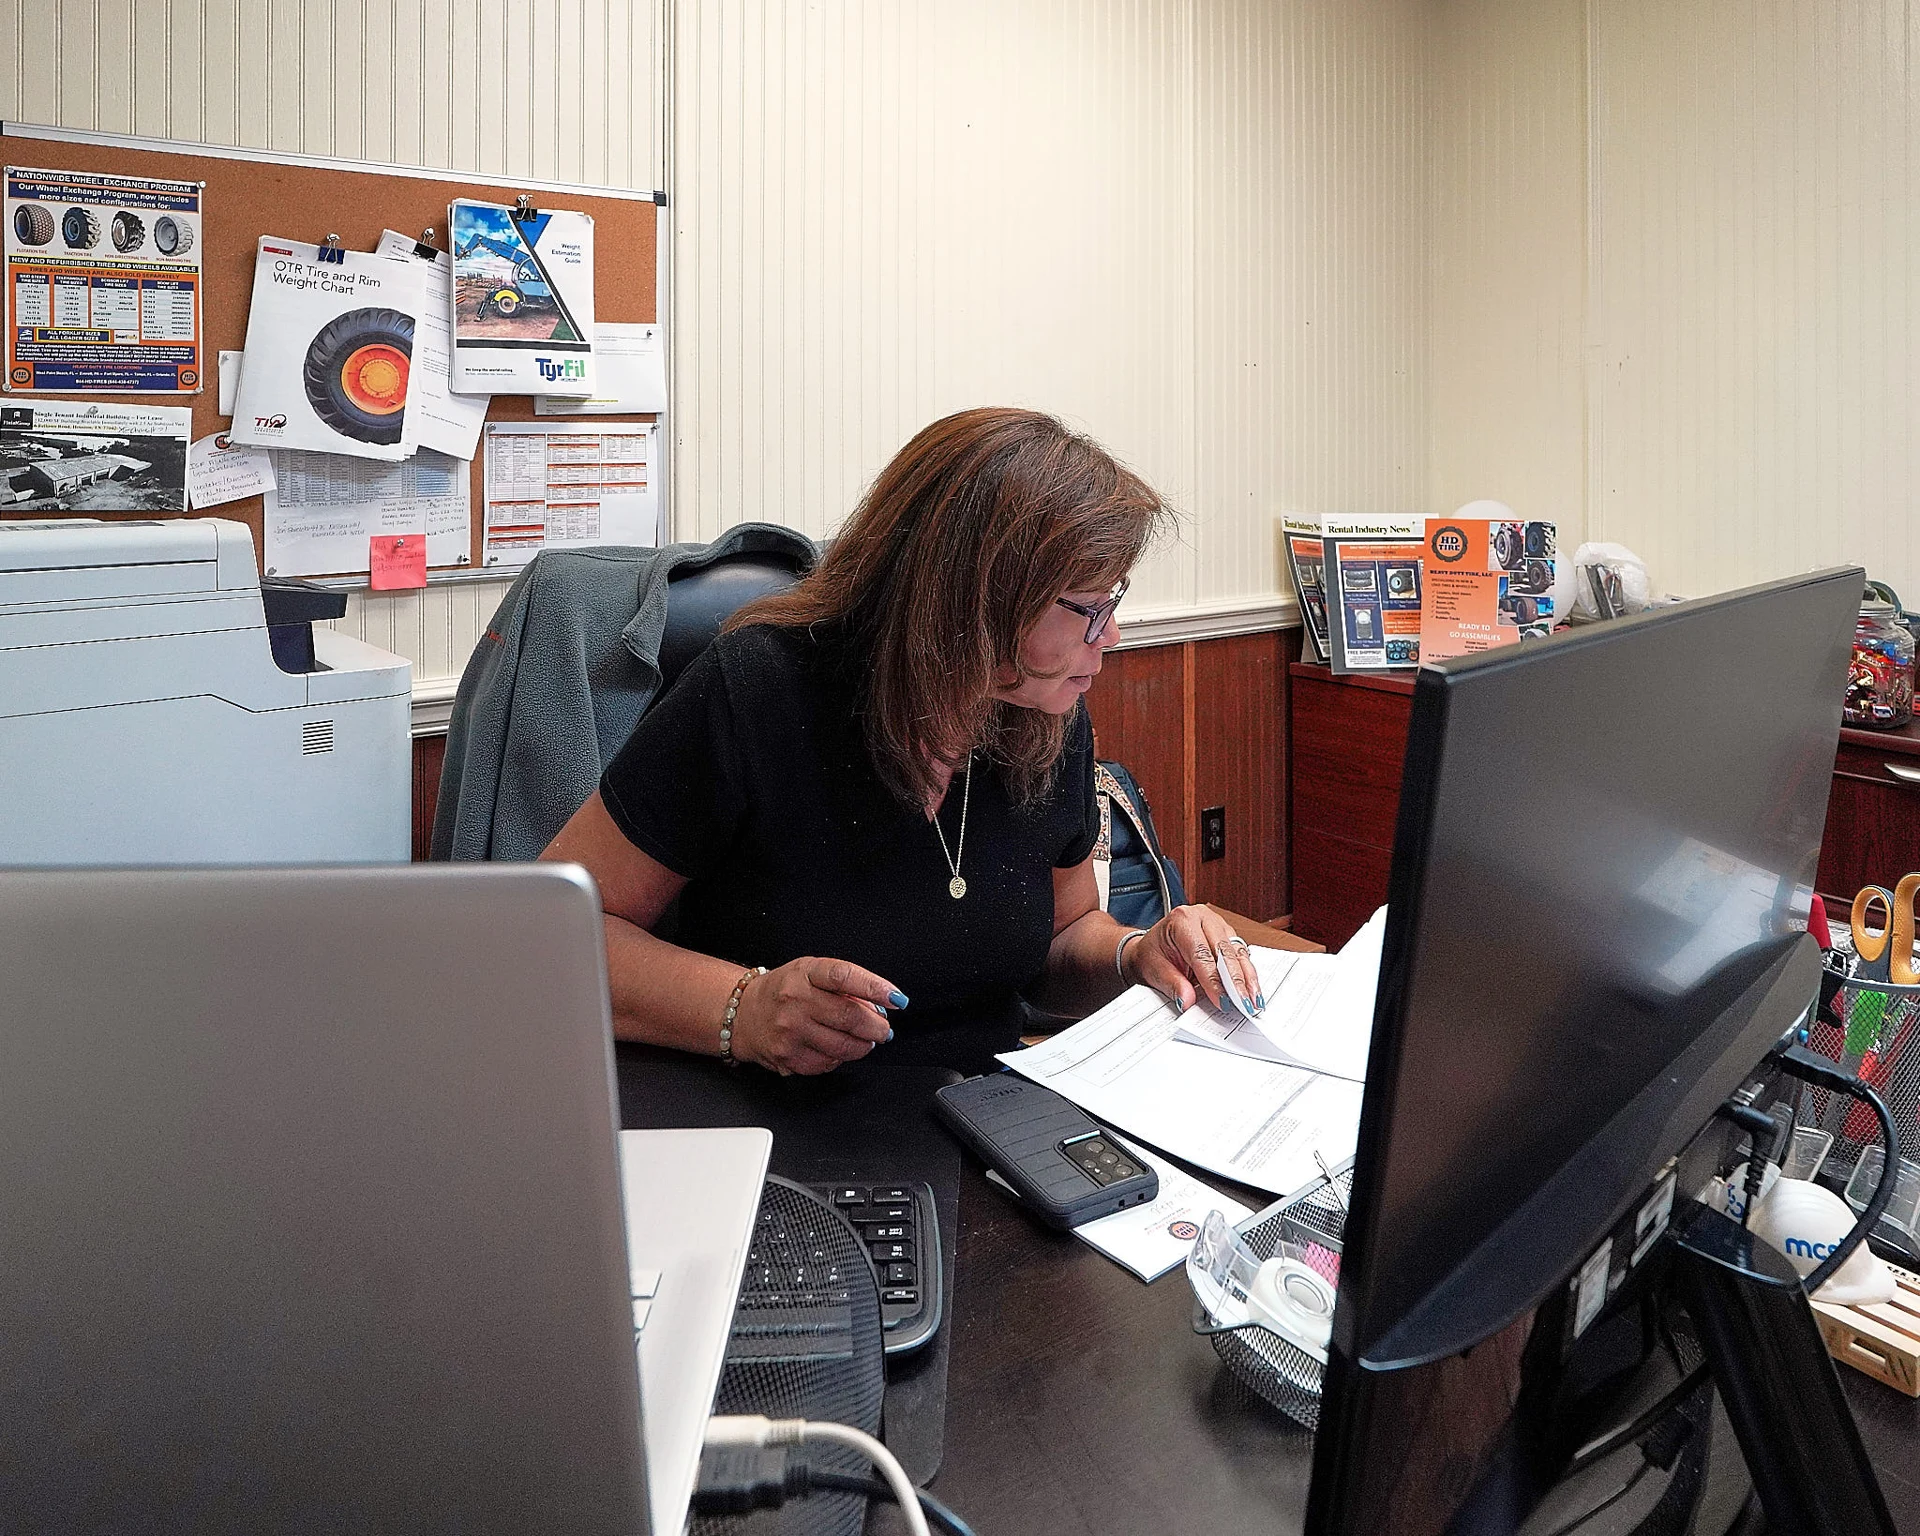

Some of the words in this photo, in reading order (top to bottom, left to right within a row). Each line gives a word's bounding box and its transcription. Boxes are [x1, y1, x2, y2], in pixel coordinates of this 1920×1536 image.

[16, 172, 71, 183] NATIONWIDE
[72, 176, 103, 185] WHEEL
[104, 178, 149, 189] EXCHANGE
[150, 183, 191, 193] PROGRAM
[35, 184, 61, 192] Wheel
[62, 186, 102, 197] Exchange
[103, 190, 139, 200] Program,
[158, 195, 189, 204] includes
[62, 194, 82, 202] sizes
[84, 196, 99, 204] and
[100, 198, 156, 209] configurations
[551, 249, 582, 257] Estimation
[46, 258, 95, 267] REFURBISHED
[274, 260, 303, 274] OTR
[306, 265, 329, 279] Tire
[332, 273, 355, 283] and
[358, 274, 381, 288] Rim
[273, 272, 318, 290] Weight
[320, 280, 354, 295] Chart
[535, 357, 586, 382] TyrFil
[1284, 520, 1297, 529] Rental
[1297, 521, 1314, 532] Industry
[1328, 525, 1354, 534] Rental
[1355, 525, 1388, 535] Industry
[1389, 525, 1411, 534] News
[1441, 536, 1459, 544] HD
[1458, 623, 1480, 631] READY
[1461, 632, 1501, 641] ASSEMBLIES
